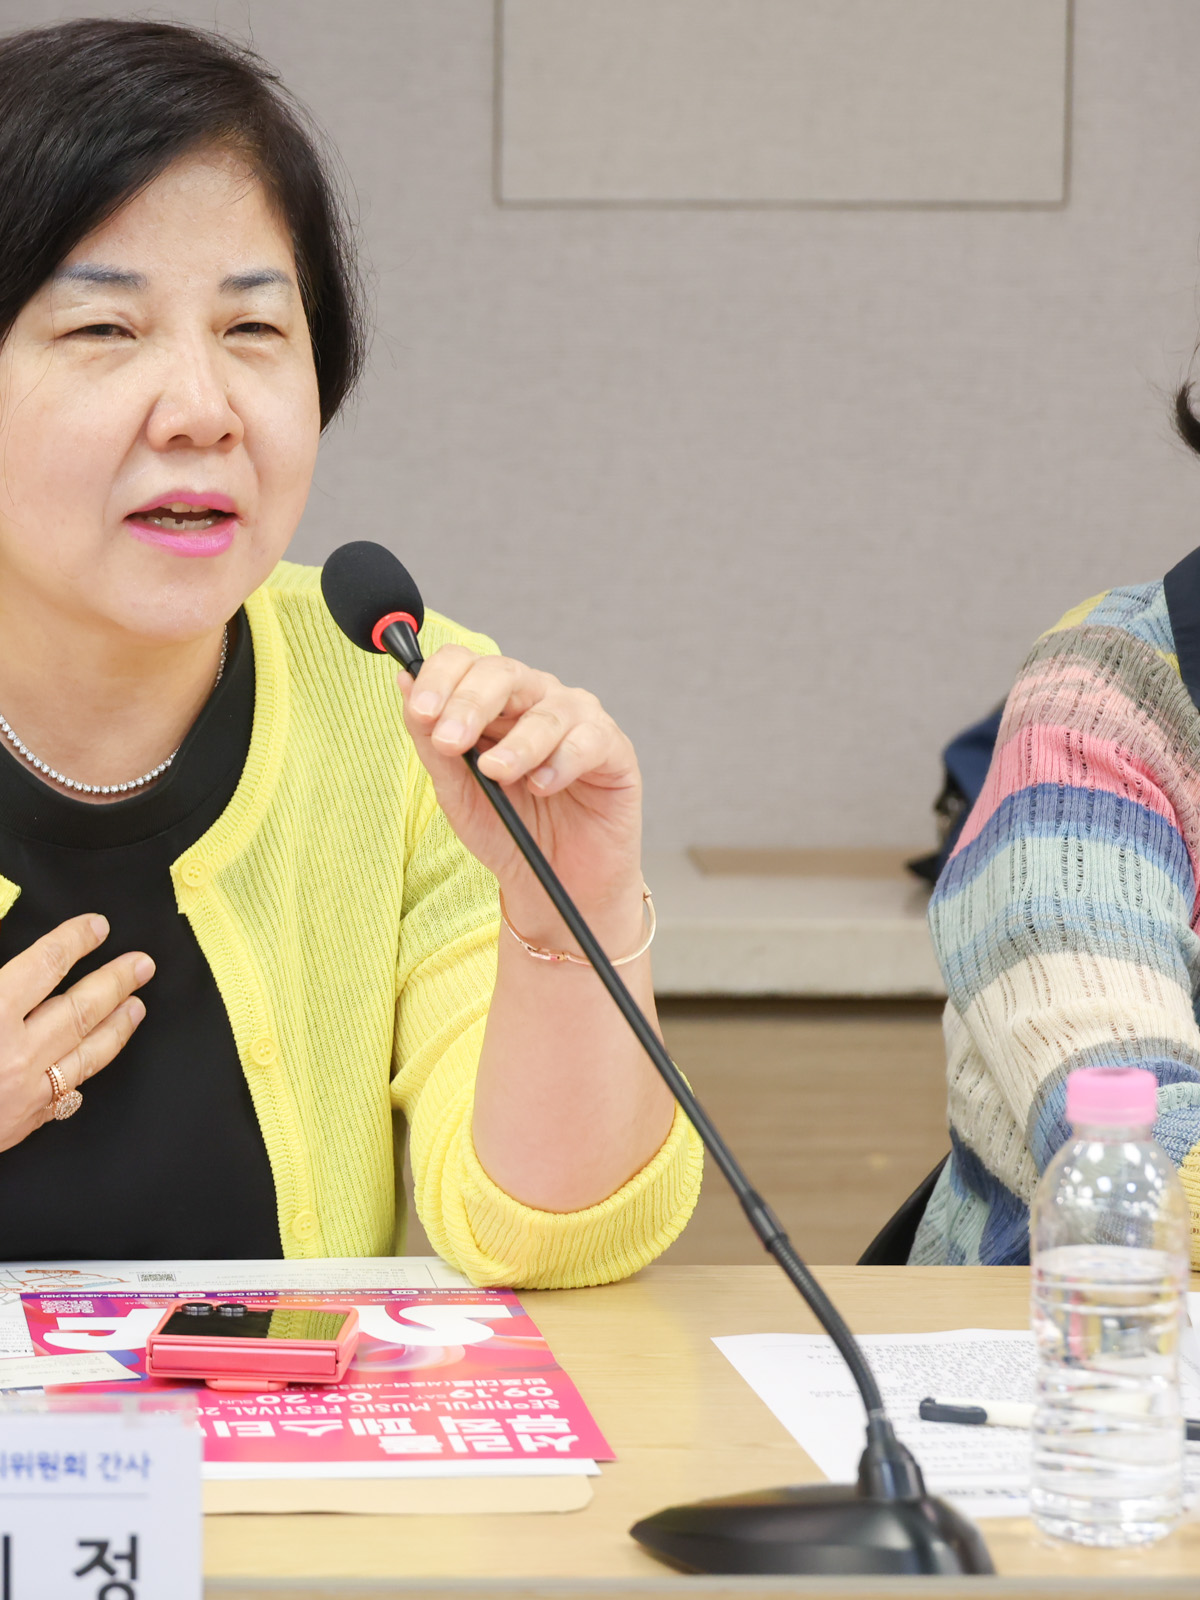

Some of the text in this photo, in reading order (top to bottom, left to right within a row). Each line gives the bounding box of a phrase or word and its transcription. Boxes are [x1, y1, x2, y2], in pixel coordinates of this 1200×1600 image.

[256, 1390, 373, 1405] 09.20
[415, 1392, 448, 1401] SAT
[448, 1385, 555, 1400] 09.19
[218, 1398, 254, 1406] SUN
[349, 1402, 430, 1414] MUSIC
[225, 1404, 342, 1417] FESTIVAL
[194, 1413, 572, 1438] 뮤직 페스티
[378, 1433, 580, 1455] 서리풀
[98, 1449, 152, 1482] 간사
